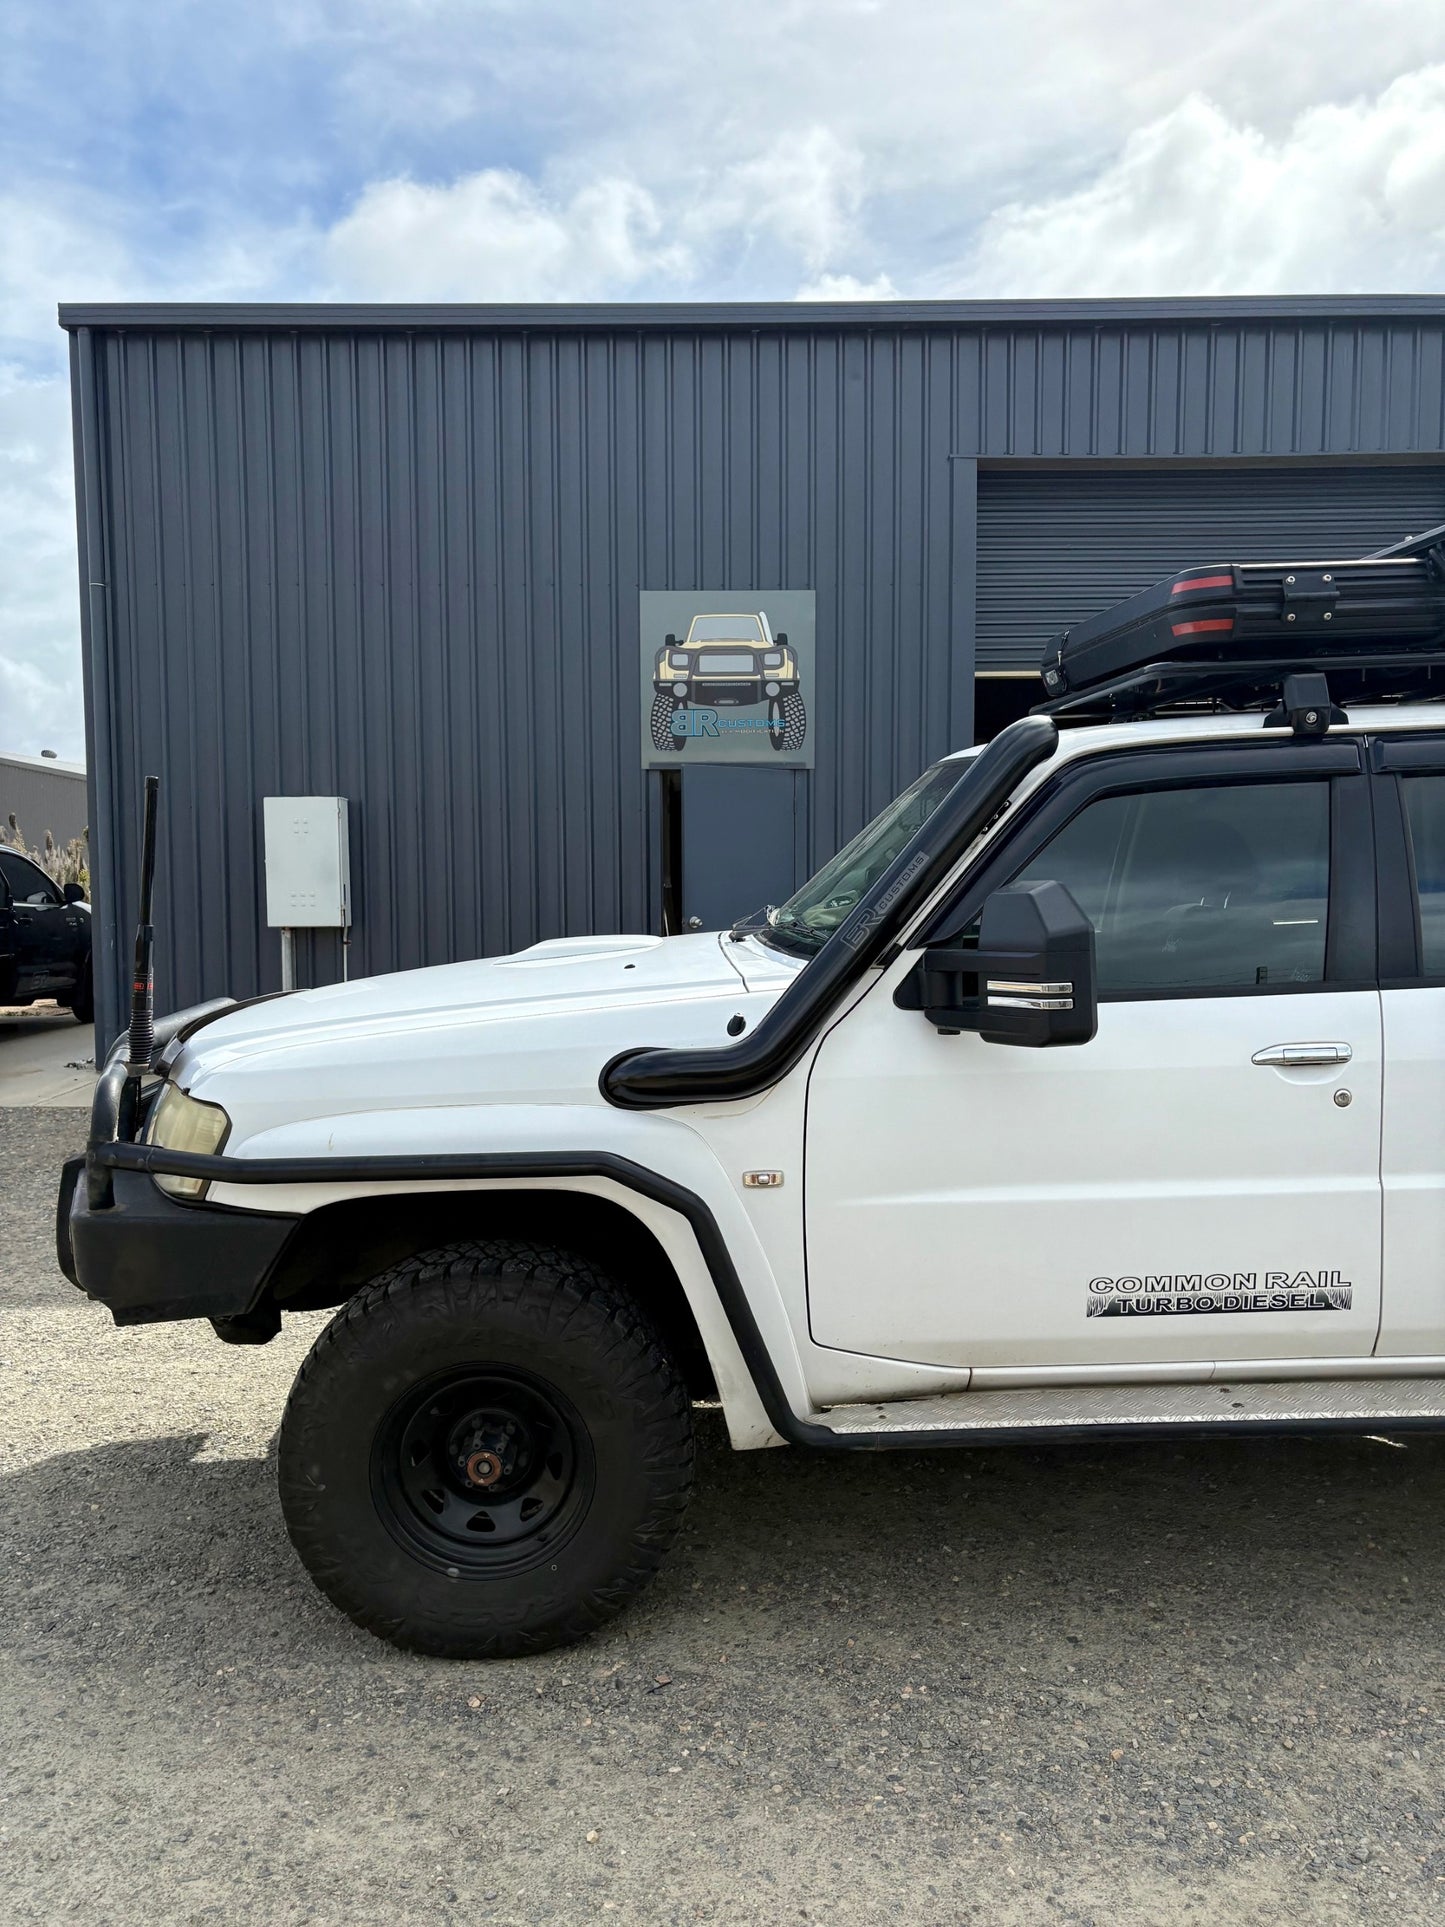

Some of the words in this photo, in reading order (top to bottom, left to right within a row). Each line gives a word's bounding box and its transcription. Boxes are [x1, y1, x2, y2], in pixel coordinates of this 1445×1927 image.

[719, 719, 786, 728] CUSTOMS
[879, 857, 924, 910] CUSTOMS
[1089, 1273, 1256, 1294] COMMON
[1265, 1271, 1352, 1289] RAIL
[1117, 1295, 1219, 1313] TURBO
[1223, 1293, 1325, 1309] DIESEL
